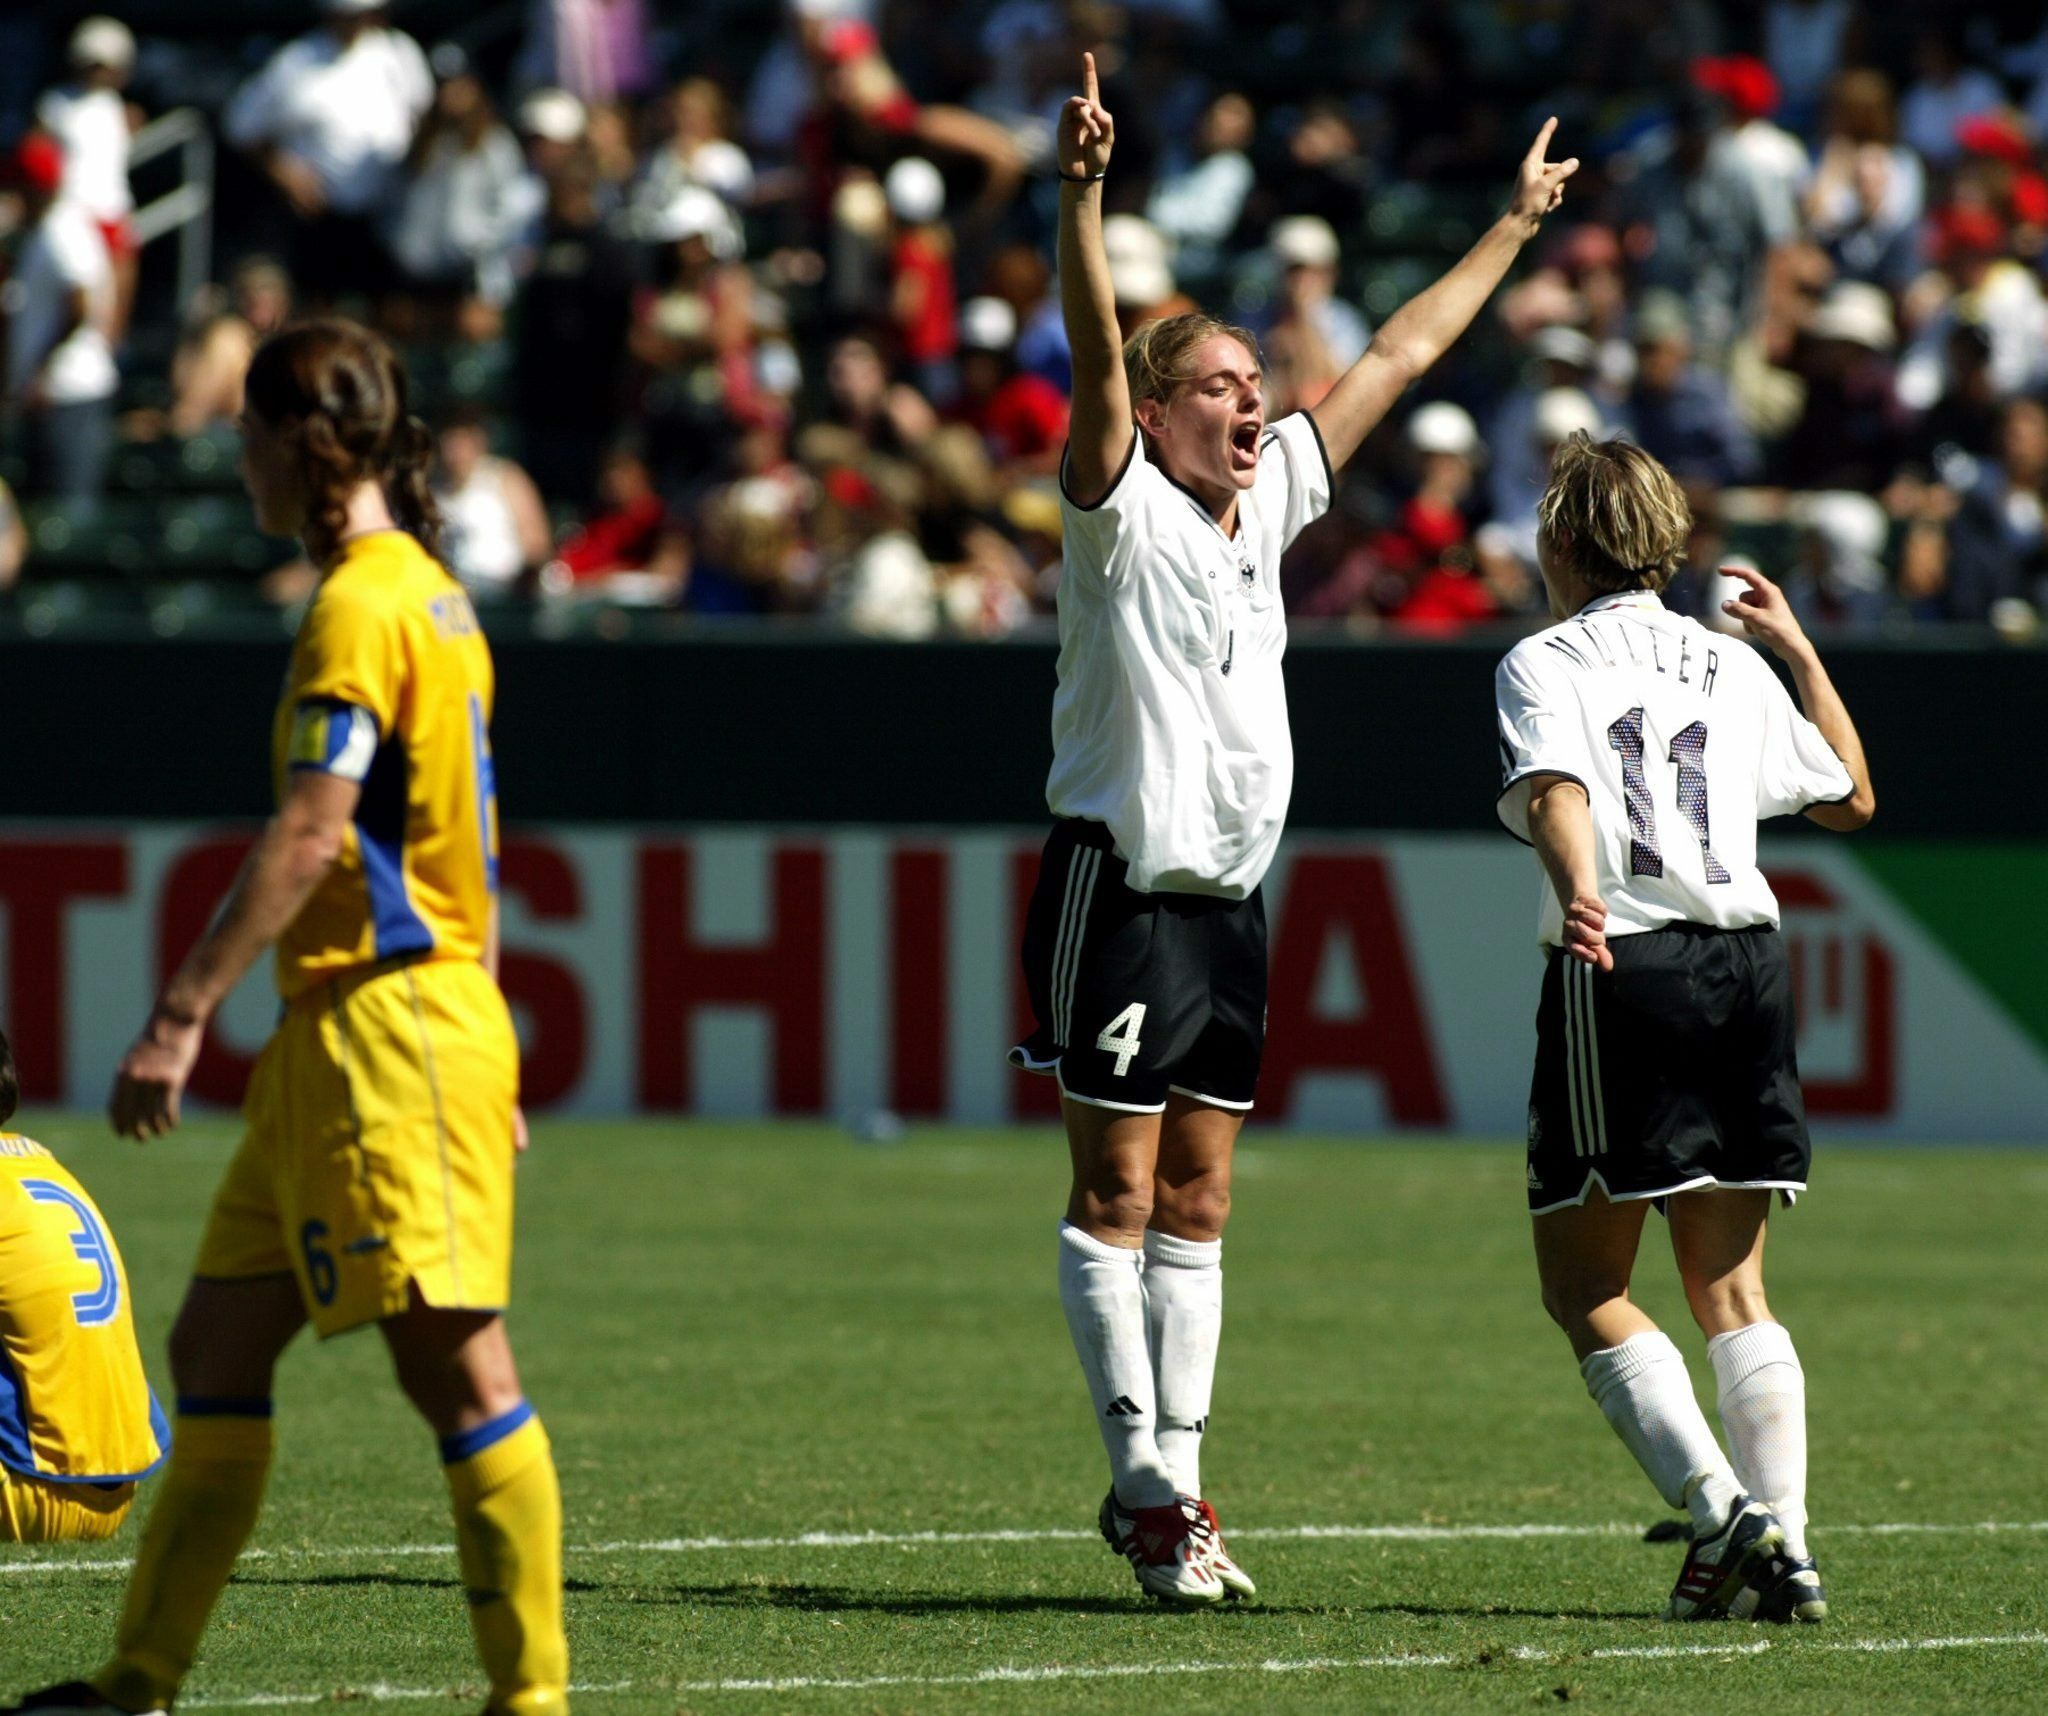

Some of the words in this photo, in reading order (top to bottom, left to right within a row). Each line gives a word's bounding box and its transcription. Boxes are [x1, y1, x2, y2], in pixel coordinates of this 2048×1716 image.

[1606, 706, 1732, 884] 11
[0, 830, 1454, 1130] TOSHIA
[1095, 1002, 1147, 1077] 4
[19, 1178, 119, 1326] 3
[301, 1216, 339, 1307] 6
